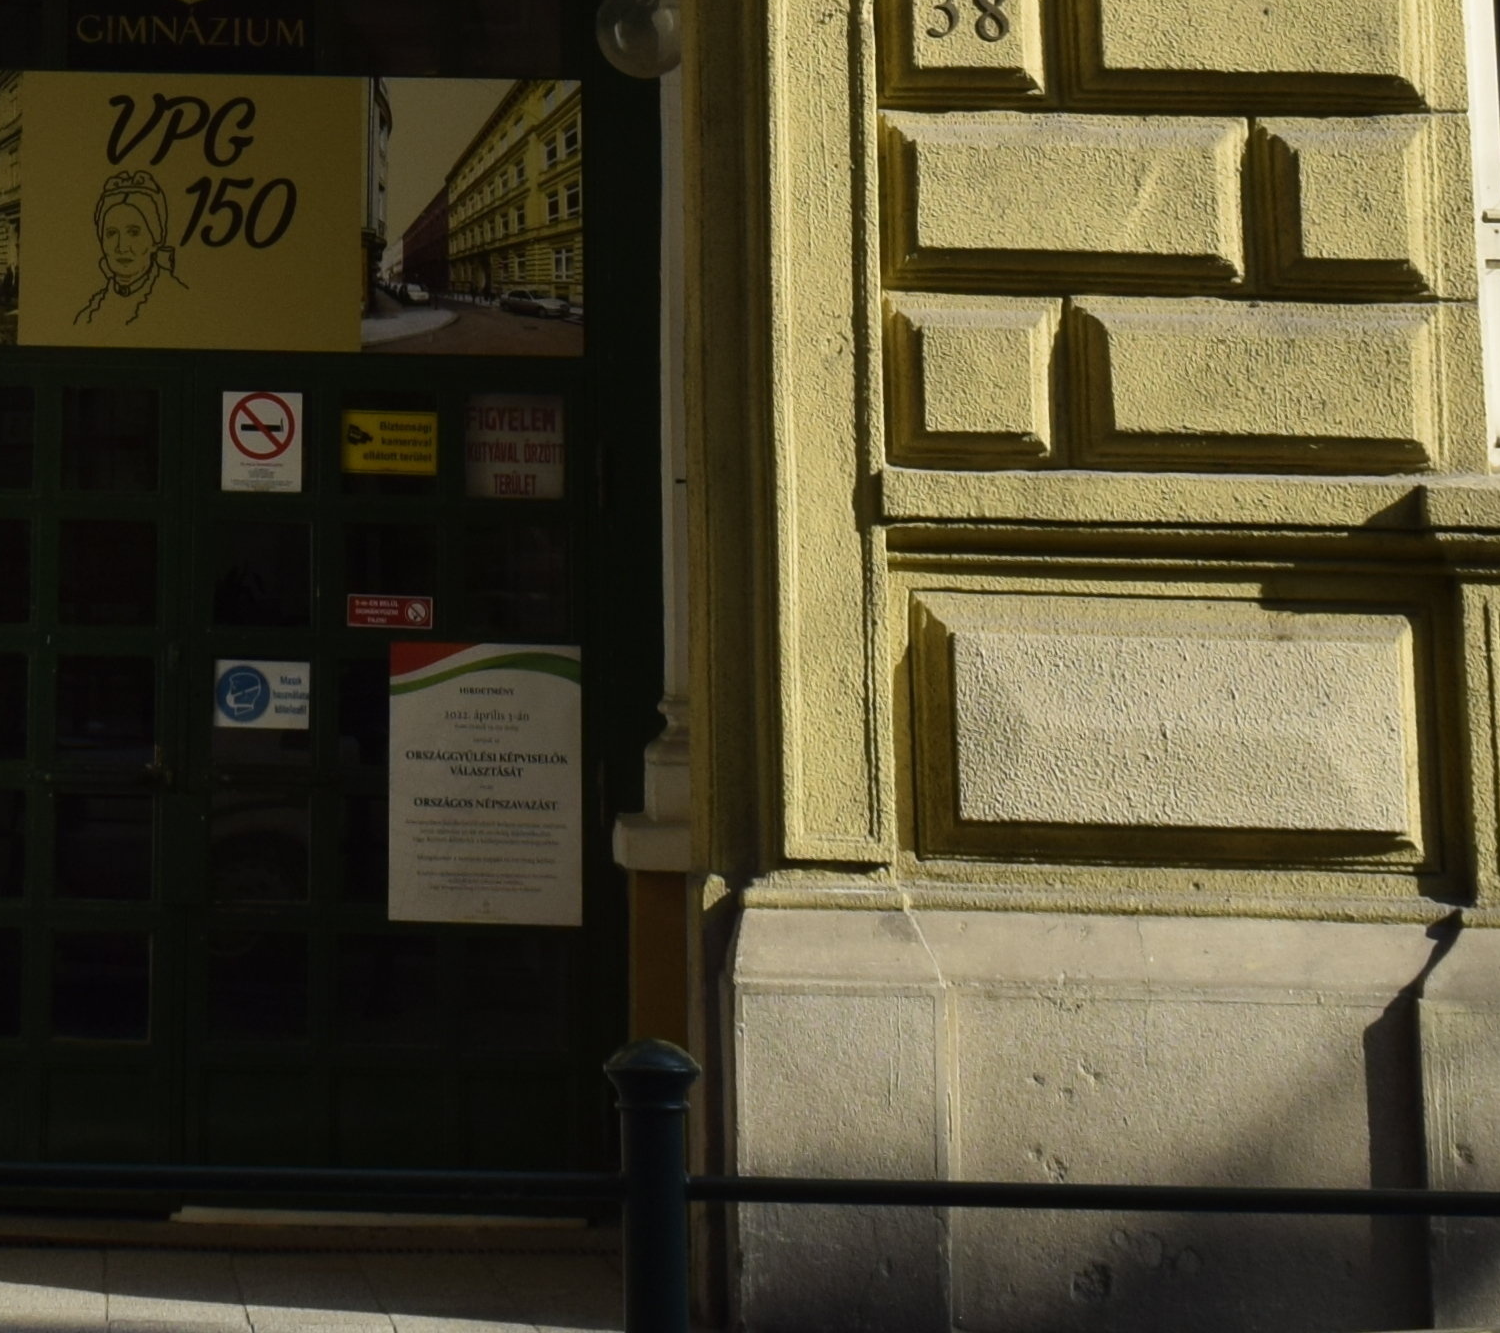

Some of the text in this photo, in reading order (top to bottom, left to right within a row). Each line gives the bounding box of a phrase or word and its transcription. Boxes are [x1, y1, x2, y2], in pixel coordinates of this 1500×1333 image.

[76, 7, 306, 48] GIMNÁZIUM
[106, 93, 256, 167] VPG
[180, 176, 297, 248] 150
[464, 405, 556, 432] FIGYELEM
[493, 470, 536, 496] TERÜLET
[459, 686, 515, 696] HIRDETMÉNY
[473, 709, 506, 723] április
[450, 764, 524, 778] VÁLASZTÁSÁT
[413, 796, 558, 811] ORSZÁGOS NÉPSZAVAZÁST
